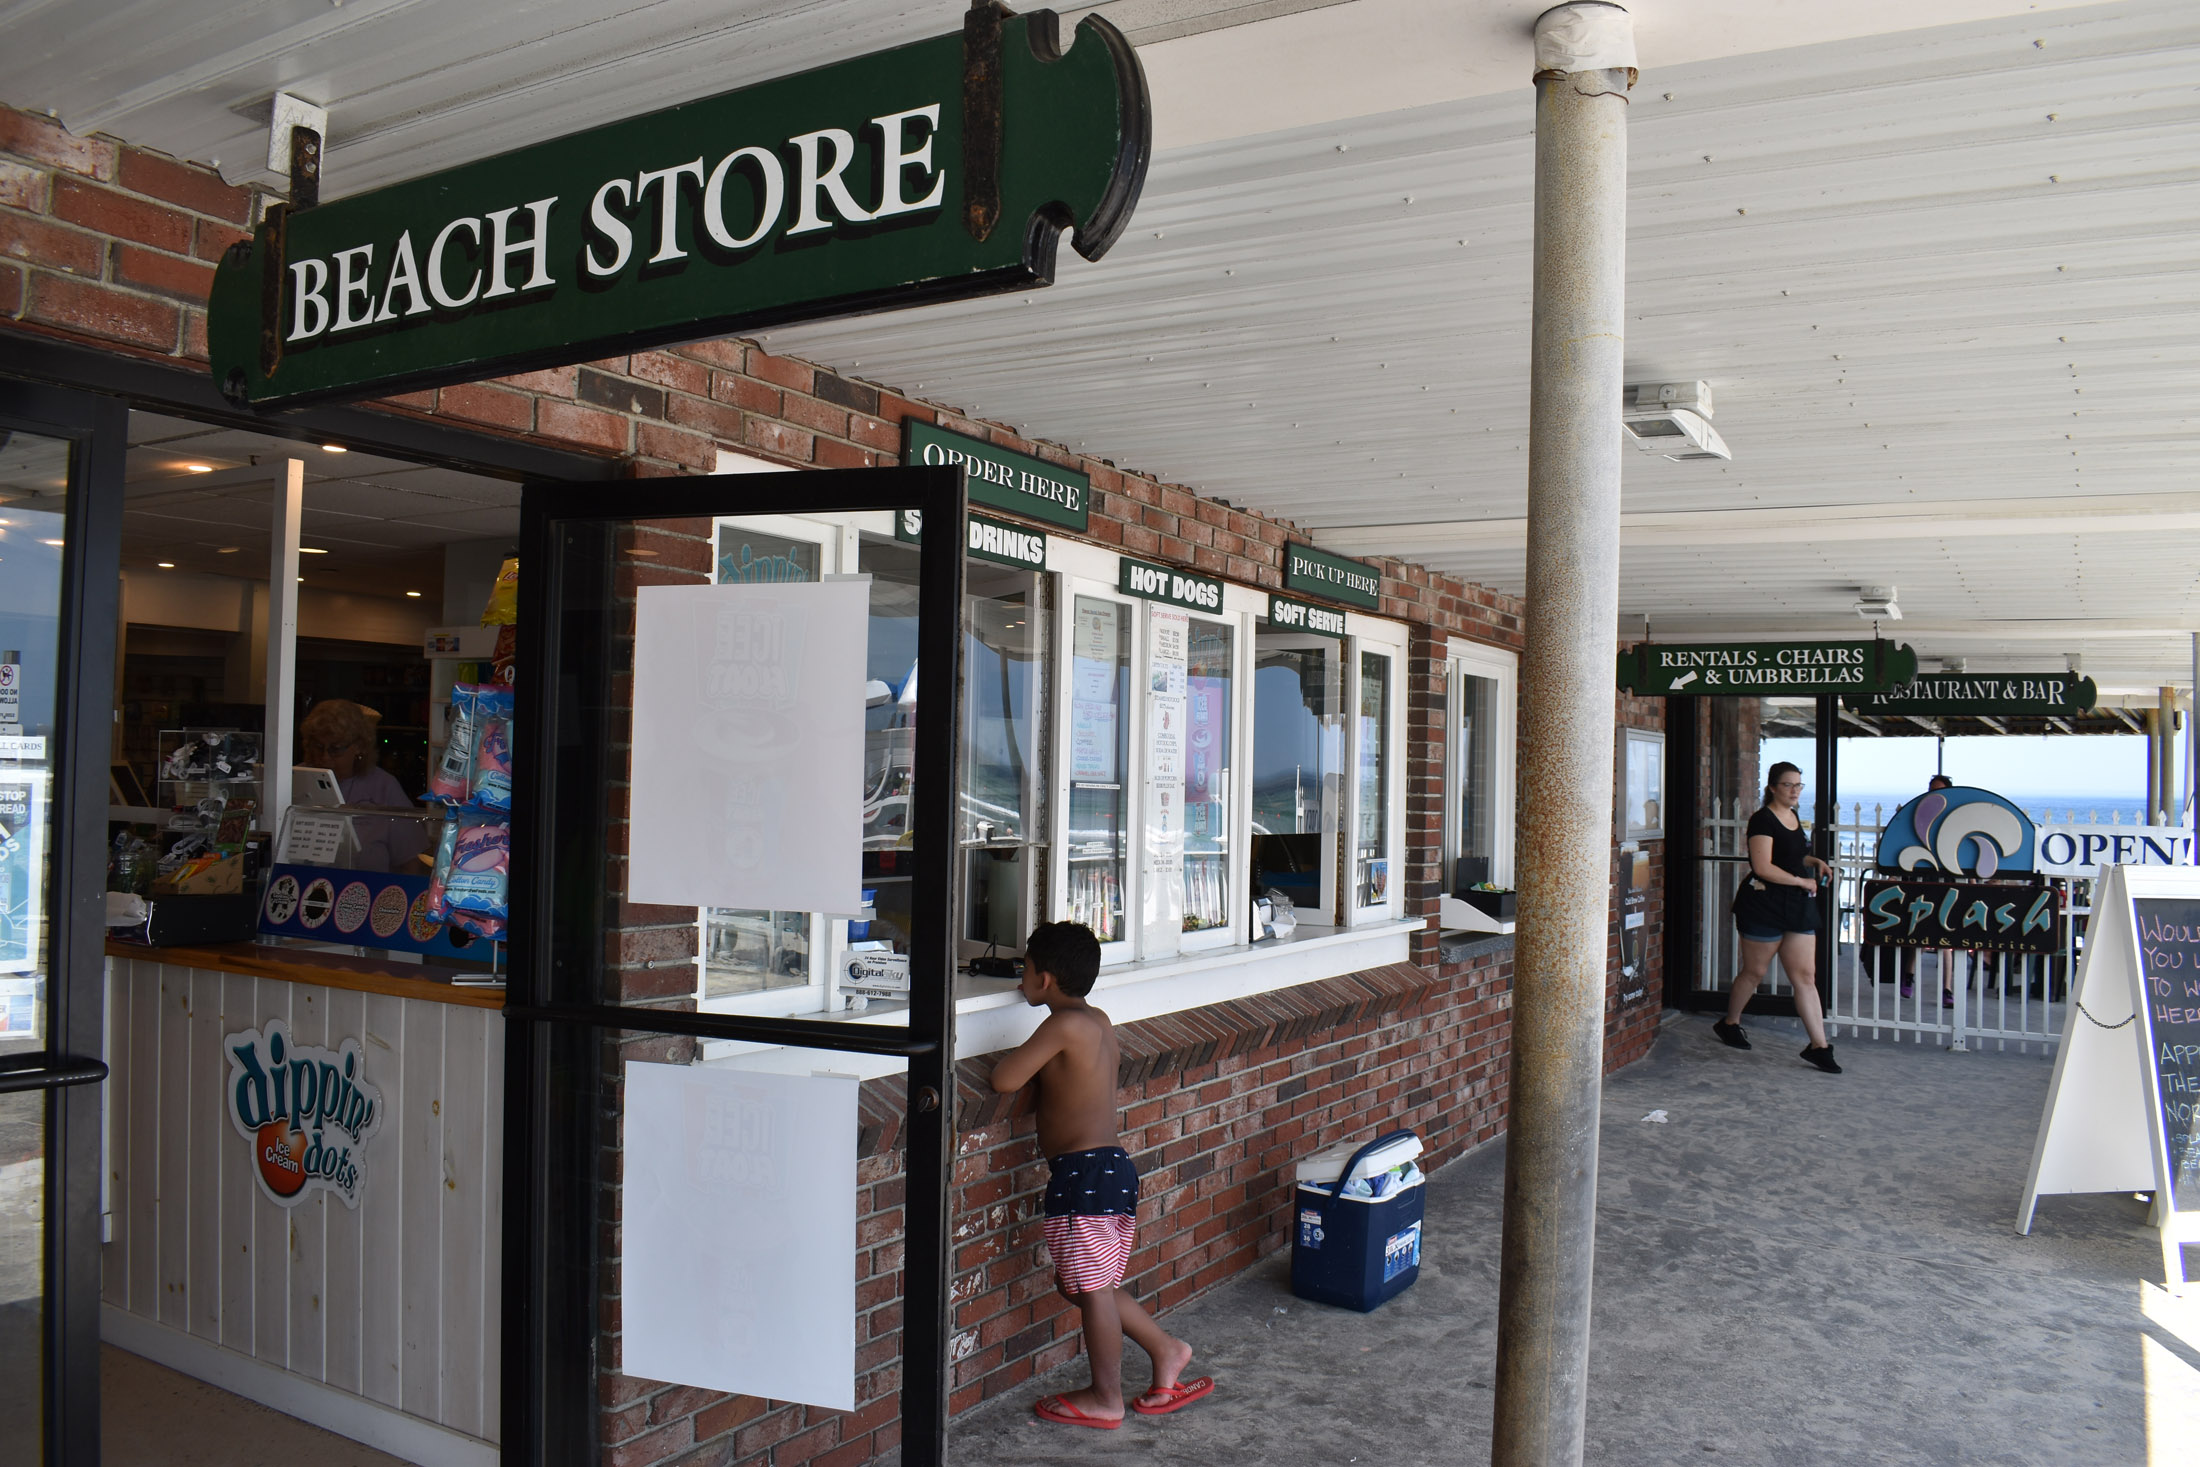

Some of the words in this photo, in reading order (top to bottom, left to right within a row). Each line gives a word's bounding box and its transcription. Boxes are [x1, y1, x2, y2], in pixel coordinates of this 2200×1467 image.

[285, 195, 559, 343] BEACH
[584, 102, 947, 278] STORE
[1018, 470, 1081, 511] HERE
[969, 520, 1044, 564] DRINKS
[1130, 565, 1169, 596] HOT
[1172, 574, 1219, 608] DOGS
[1292, 556, 1326, 580] PICK
[1327, 566, 1345, 584] UP
[1346, 572, 1378, 596] HERE
[1274, 600, 1307, 627] SOFT
[1308, 607, 1344, 634] SERVE
[1659, 650, 1757, 667] RENTALS
[1775, 647, 1864, 665] CHAIRS
[1704, 669, 1722, 685] &
[1727, 666, 1865, 684] UMBRELLAS
[2002, 680, 2017, 700] &
[2022, 680, 2065, 705] BAR
[10, 742, 43, 750] CARDS
[1869, 885, 2051, 937] Splash
[1884, 934, 1930, 945] Food
[1938, 936, 1952, 946] &
[1961, 938, 2037, 950] Spirits
[2144, 946, 2184, 971] YOU
[2147, 976, 2172, 998] TO
[2160, 1041, 2200, 1065] APP
[233, 1031, 374, 1140] dippin'
[275, 1136, 292, 1157] Ice
[303, 1131, 358, 1190] dots
[264, 1147, 300, 1175] Cream
